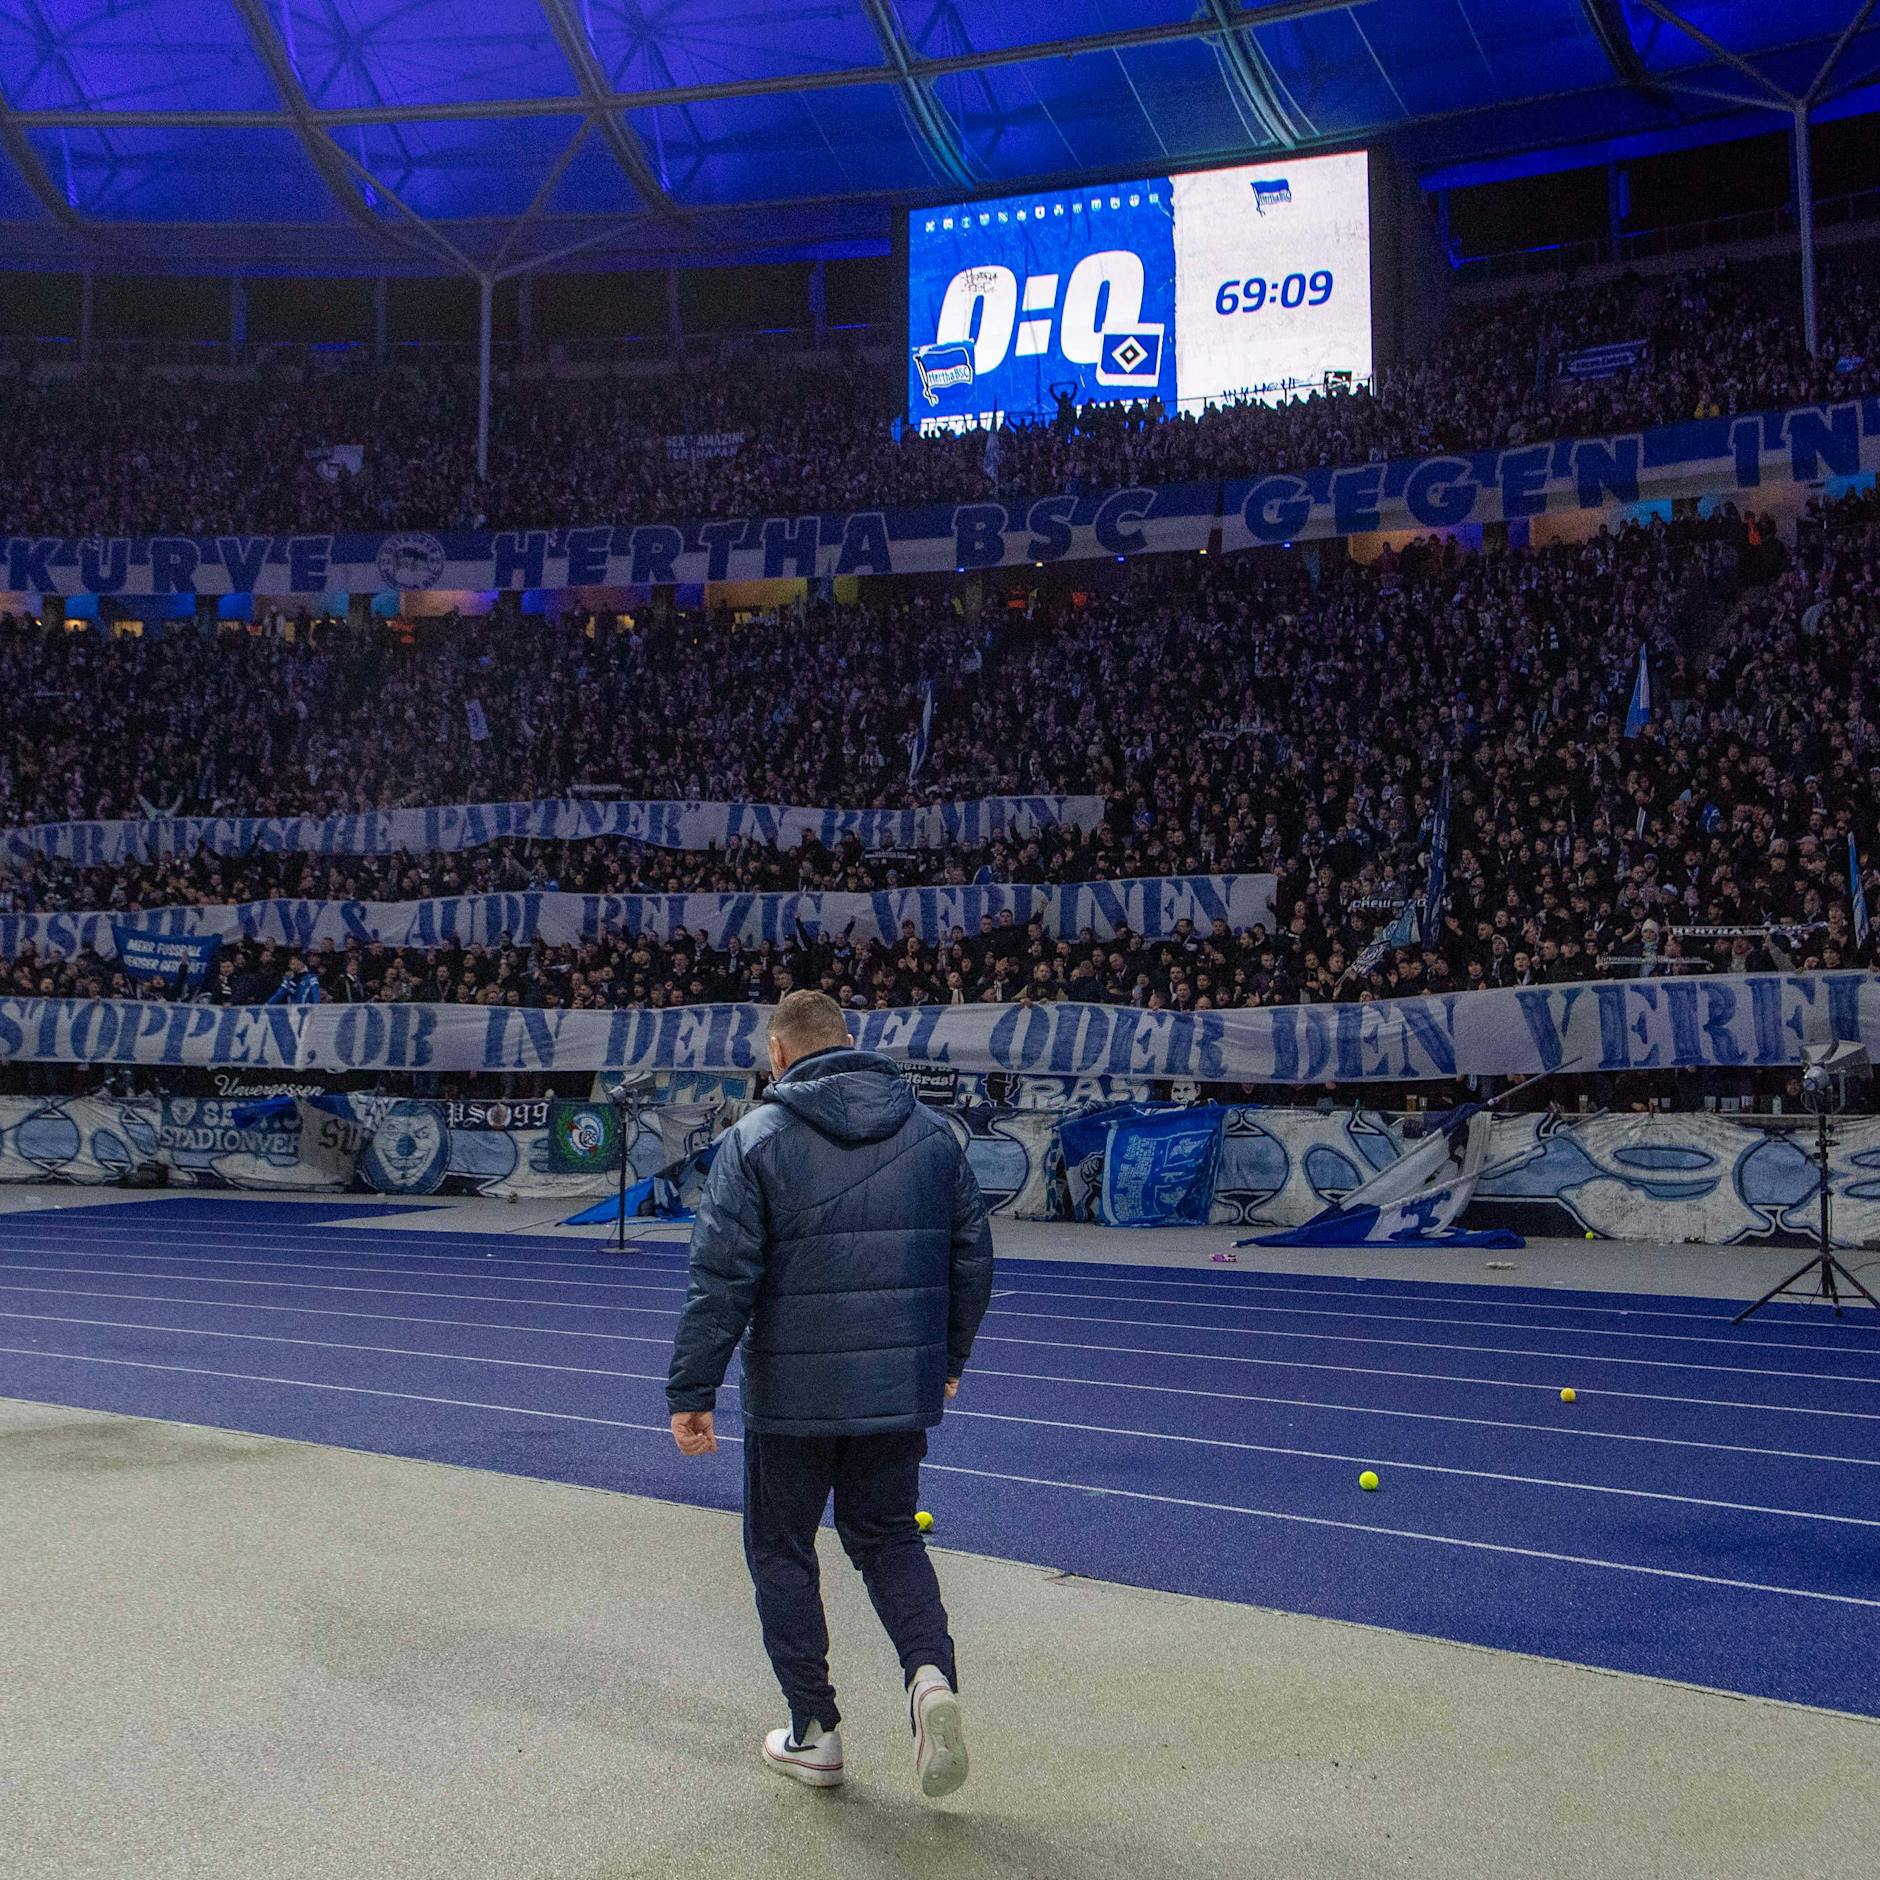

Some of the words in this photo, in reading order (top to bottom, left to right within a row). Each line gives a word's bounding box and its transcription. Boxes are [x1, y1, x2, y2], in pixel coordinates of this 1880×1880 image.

[936, 250, 1145, 376] 0:0
[1215, 270, 1333, 316] 69:09
[6, 535, 334, 594] KURVE
[494, 511, 893, 588] HERTHA
[952, 488, 1158, 569] BSC
[1243, 433, 1644, 541] GEGEN
[727, 803, 791, 848] IN
[405, 892, 545, 948] AUDI
[0, 1000, 317, 1065] STOPPEN,
[335, 1004, 437, 1068] OB
[483, 1008, 571, 1068] IN
[603, 1003, 760, 1069] DER
[988, 1002, 1229, 1079] ODER
[1270, 1000, 1457, 1080] DEN
[214, 1074, 325, 1097] Unvergessen
